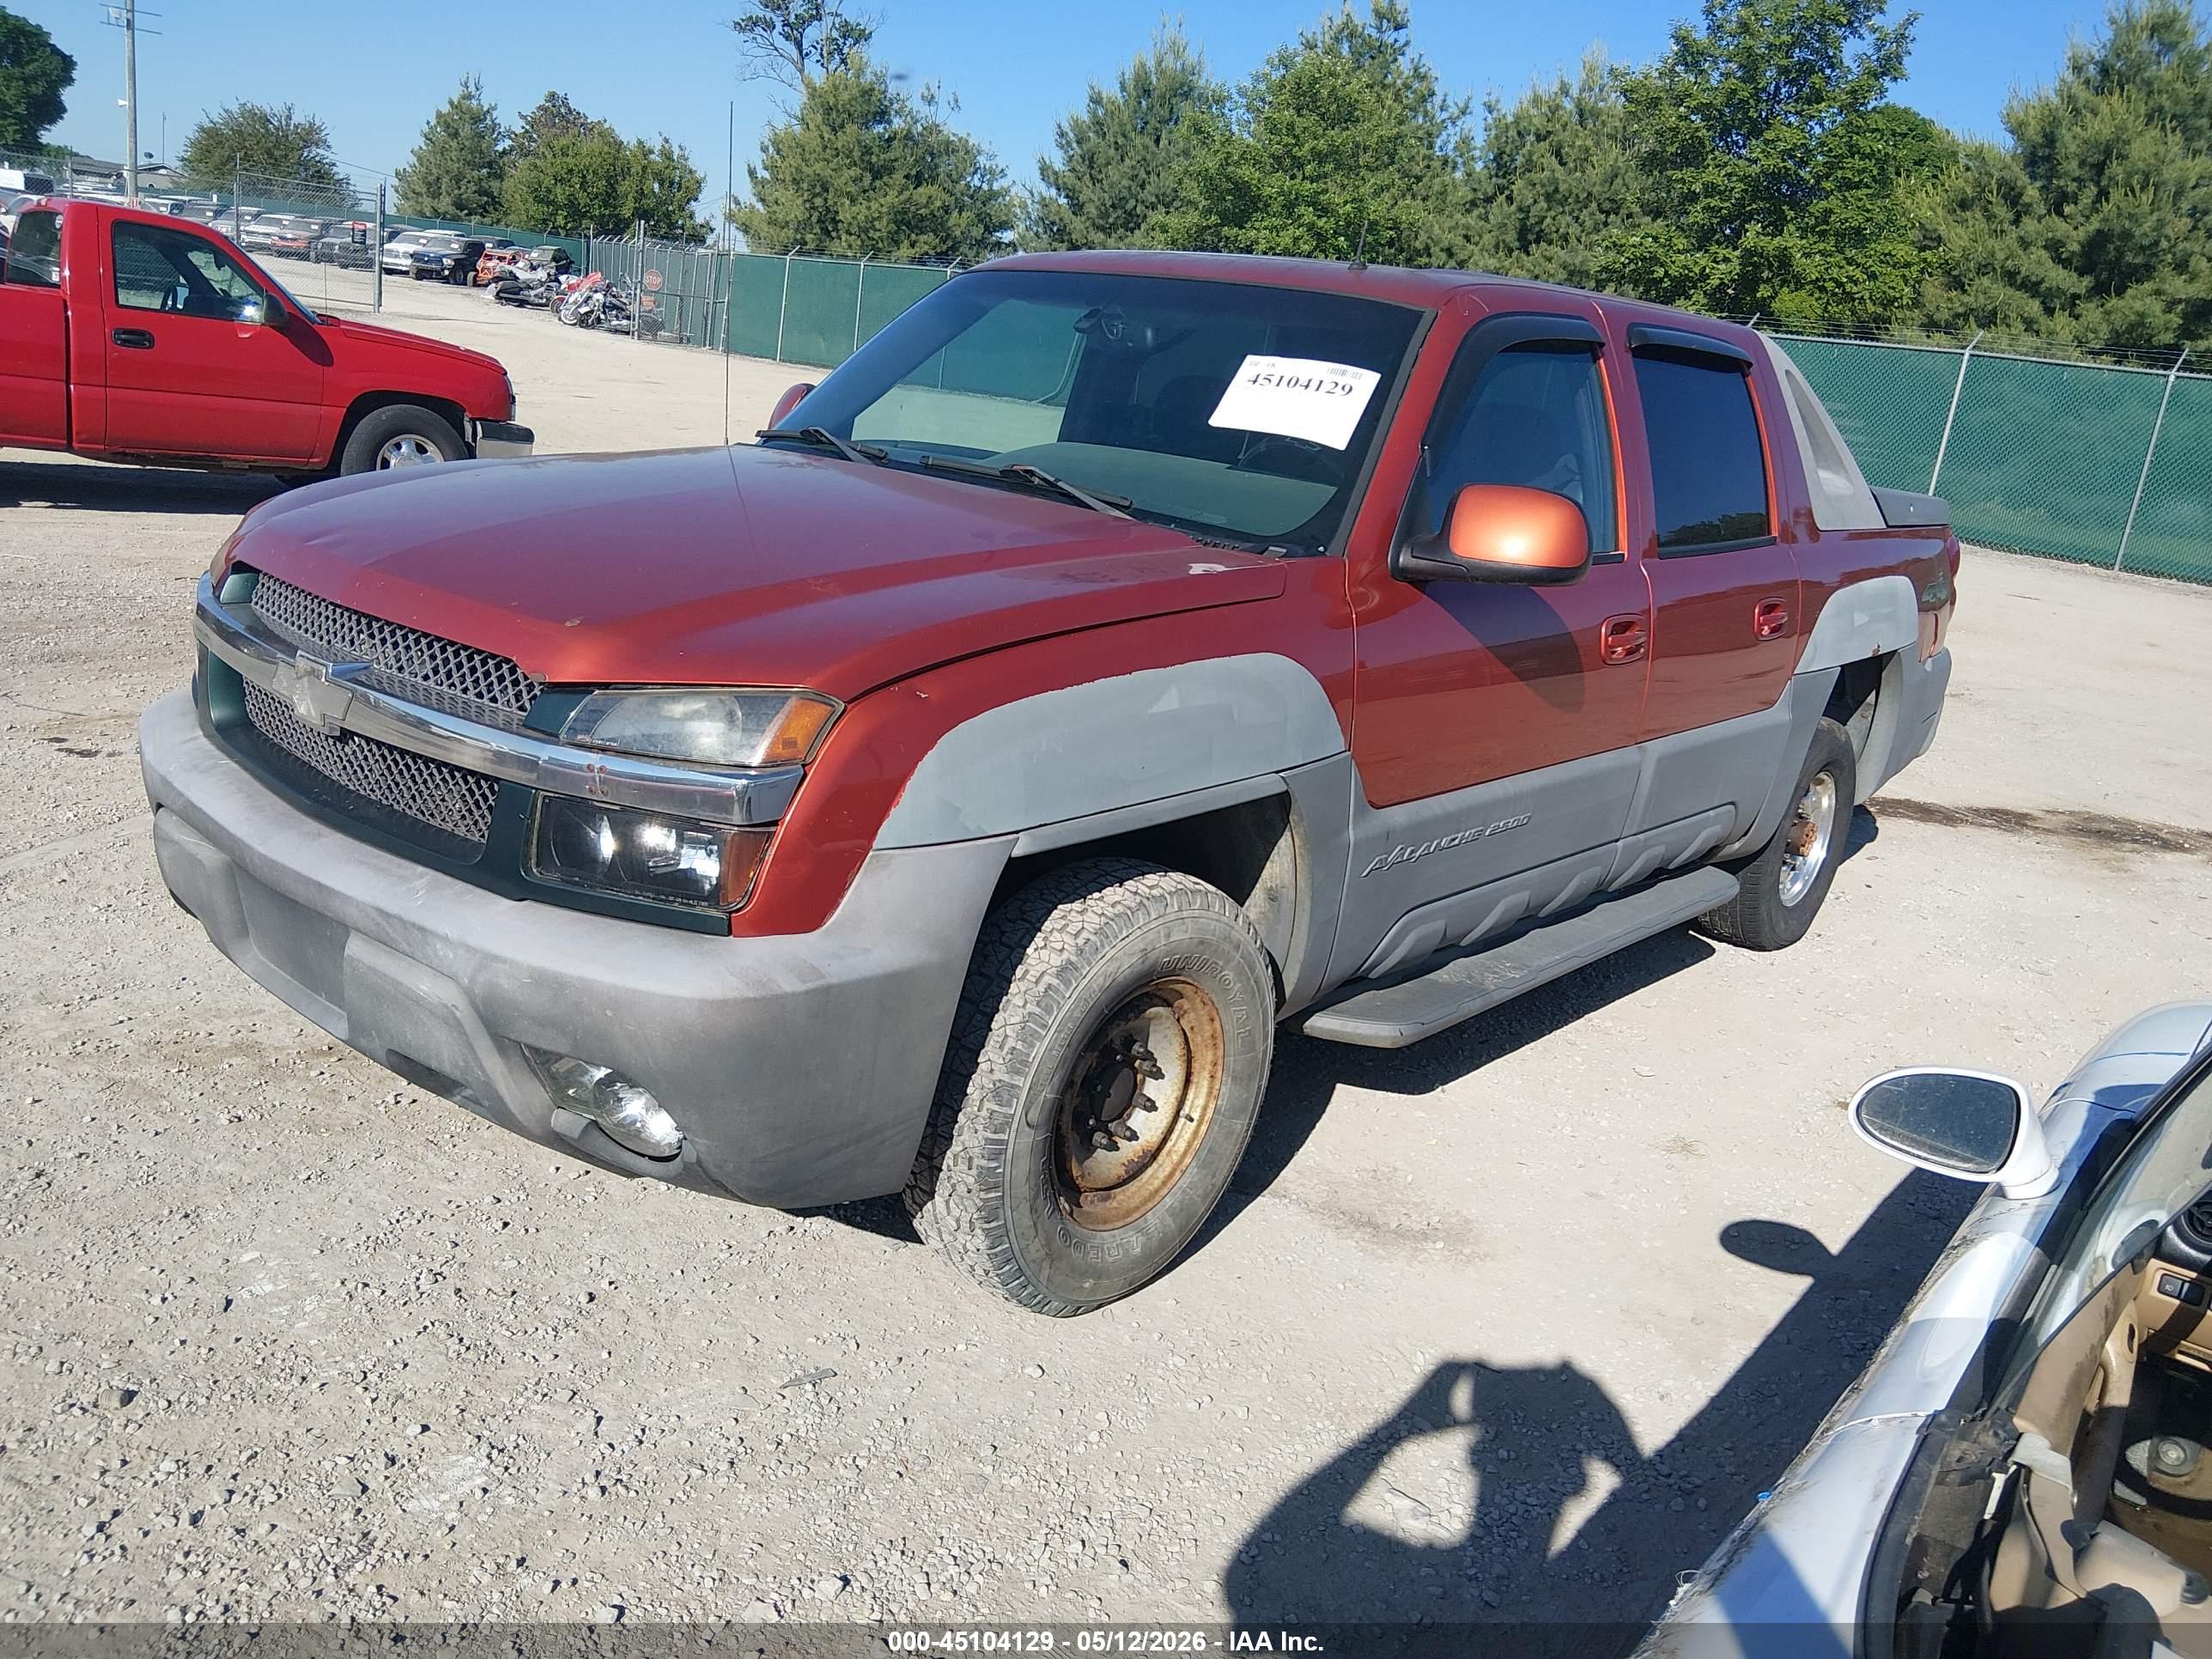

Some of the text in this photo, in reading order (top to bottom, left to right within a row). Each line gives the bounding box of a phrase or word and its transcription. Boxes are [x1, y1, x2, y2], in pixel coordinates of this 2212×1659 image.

[646, 275, 661, 284] STOP
[1248, 373, 1353, 397] 45104129
[1360, 812, 1532, 878] AVALANCHE 2500
[1159, 954, 1251, 1048] UNIROYAL
